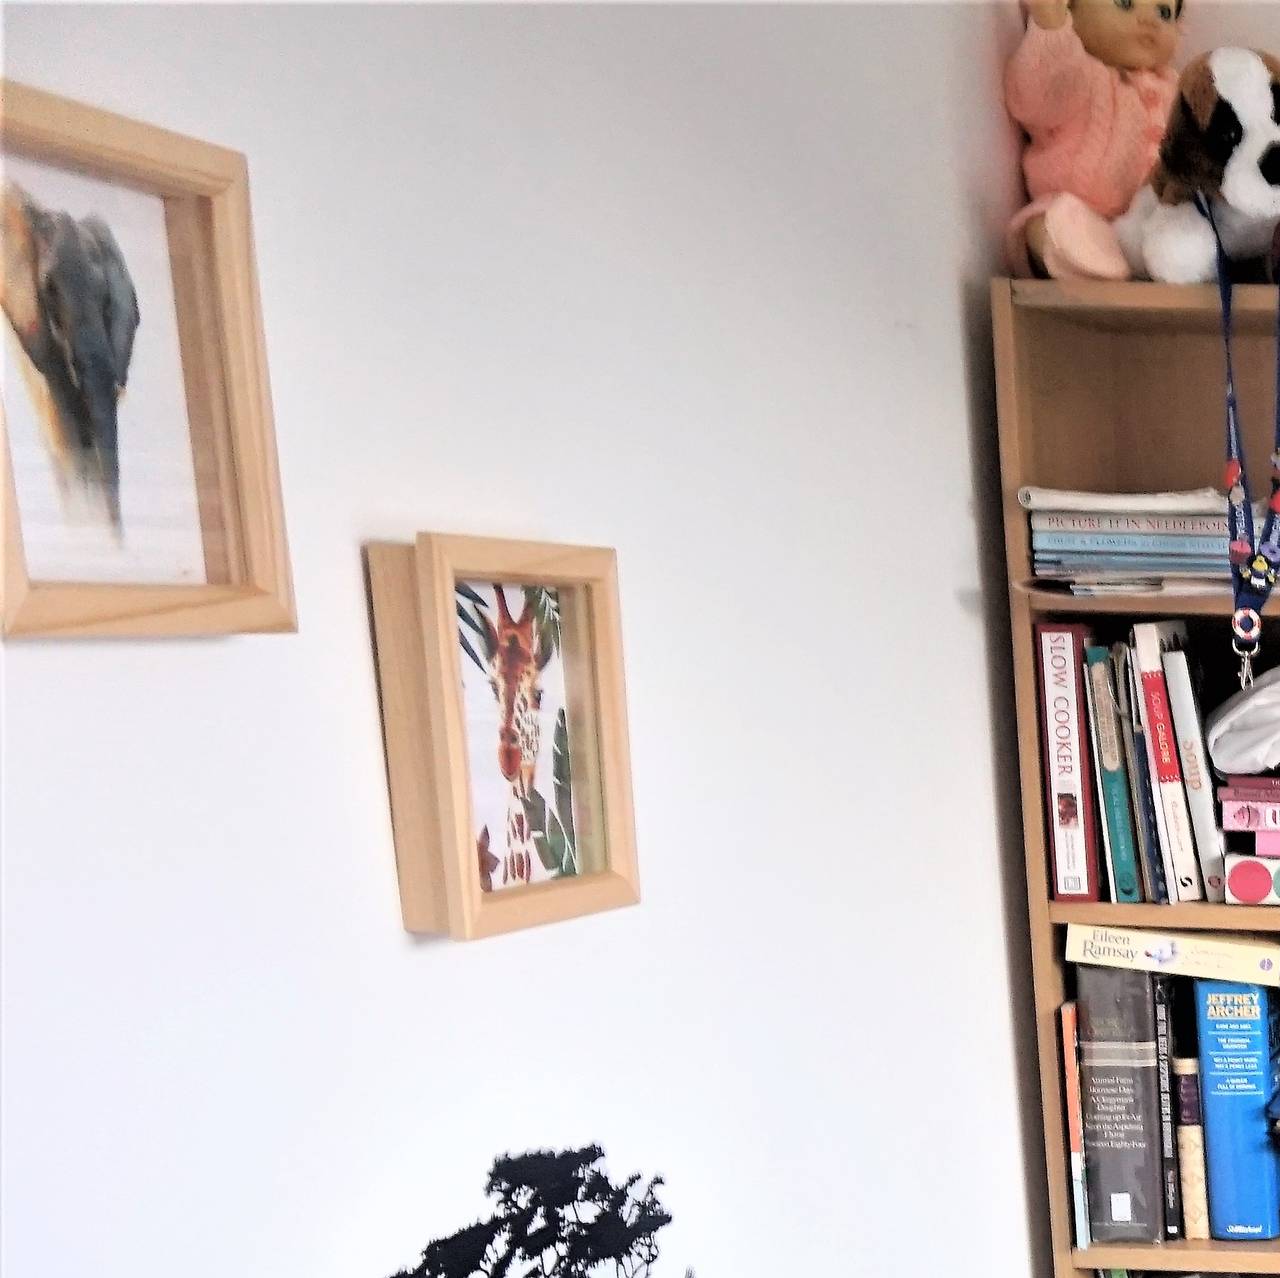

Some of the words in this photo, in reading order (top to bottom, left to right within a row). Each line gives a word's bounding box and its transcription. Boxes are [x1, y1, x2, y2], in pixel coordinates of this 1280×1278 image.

[1146, 518, 1230, 532] NEEDLEPOIN
[1049, 634, 1067, 689] SLOW
[1053, 696, 1073, 776] COOKER
[1092, 929, 1130, 945] Eileen
[1082, 940, 1138, 961] Ramsay
[1206, 991, 1259, 1007] JEFFREY
[1206, 1005, 1261, 1019] ARCHER
